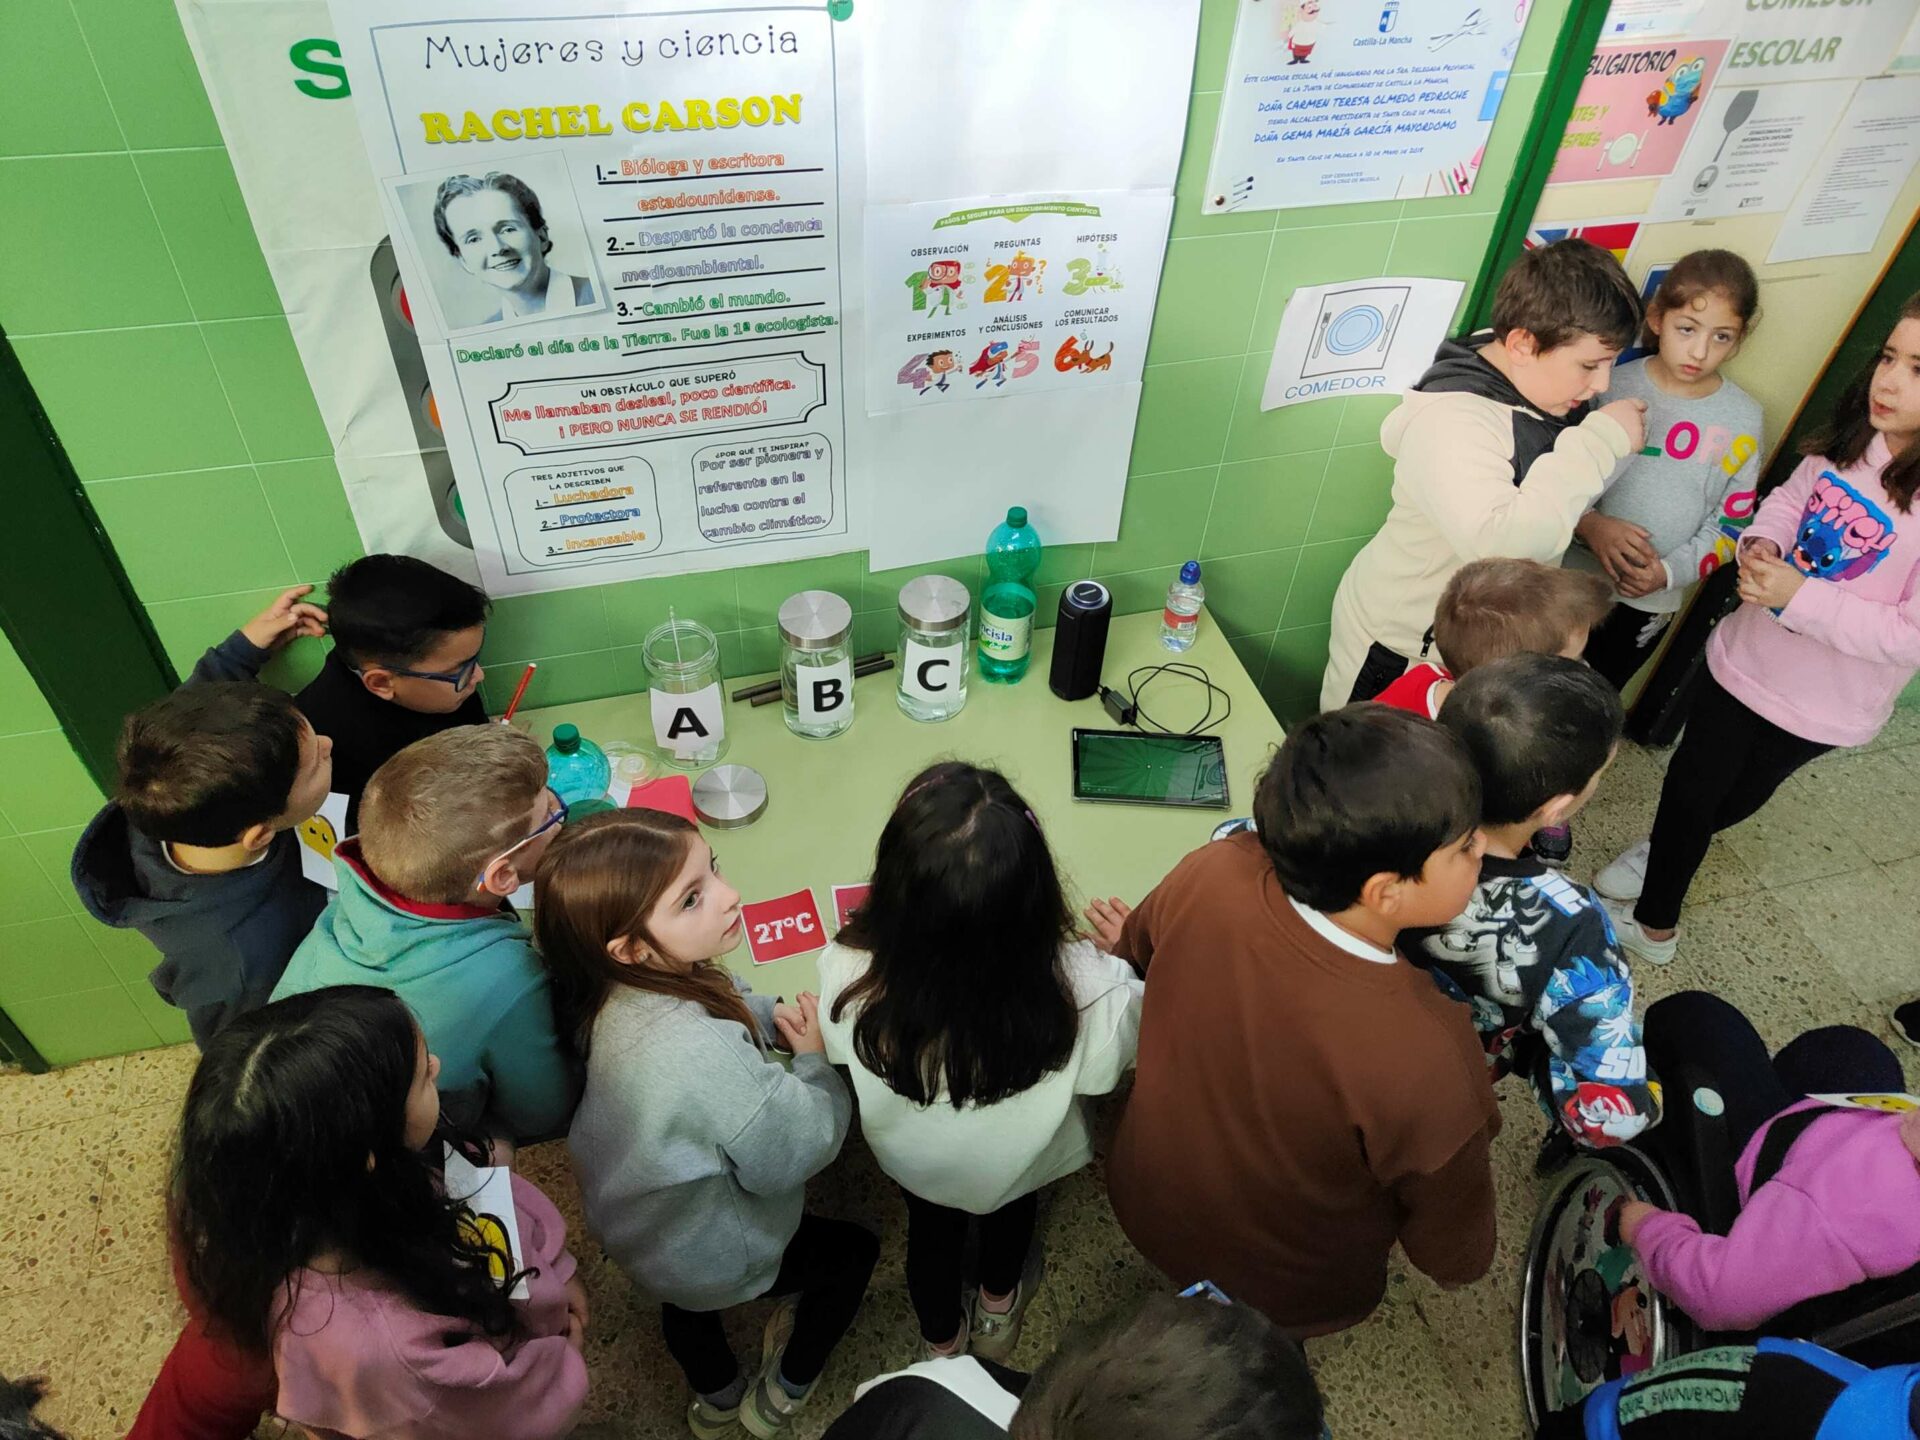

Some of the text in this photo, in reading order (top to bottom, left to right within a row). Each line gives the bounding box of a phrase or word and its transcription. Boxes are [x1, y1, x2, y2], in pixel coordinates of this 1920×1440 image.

[425, 24, 799, 72] Mujeres y ciencia
[1727, 37, 1842, 69] ESCOLAR
[1585, 49, 1677, 76] BLIGATORIO
[420, 93, 803, 144] RACHEL CARSON
[620, 158, 689, 177] Bióloga
[692, 158, 704, 174] y
[708, 153, 785, 170] escritora
[637, 188, 781, 212] estadounidense.
[638, 224, 717, 247] Despertó
[721, 223, 736, 238] la
[994, 238, 1041, 250] PREGUNTAS
[1076, 232, 1118, 244] HIPÓTESIS
[911, 243, 969, 257] OBSERVACIÓN
[622, 255, 765, 283] medioambiental.
[709, 293, 724, 308] el
[728, 289, 791, 308] mundo.
[993, 313, 1028, 324] ANÁLISIS
[1054, 315, 1118, 327] LOS RESULTADOS
[1064, 307, 1109, 318] COMUNICAR
[456, 343, 524, 363] Declaró
[527, 342, 544, 357] el
[547, 340, 574, 355] día
[578, 338, 600, 351] de
[603, 336, 620, 350] la
[623, 332, 677, 348] Tierra.
[681, 327, 711, 342] Fue
[714, 324, 729, 338] la
[754, 314, 839, 333] ecologista.
[907, 328, 966, 342] EXPERIMENTOS
[978, 322, 1043, 334] Y CONCLUSIONES
[580, 370, 736, 398] UN OBSTÁCULO QUE SUPERÓ
[1284, 375, 1386, 400] COMEDOR
[503, 378, 796, 422] Me llamaban desleal, poco científica.
[569, 422, 614, 437] PERO
[617, 413, 676, 432] NUNCA
[680, 408, 698, 423] SE
[702, 396, 768, 420] RENDIÓ!
[700, 448, 824, 472] Por ser pionera y
[739, 447, 755, 456] QUÉ
[758, 446, 768, 454] TE
[770, 441, 810, 452] INSPIRA?
[531, 465, 625, 482] TRES ADJETIVOS QUE
[564, 478, 612, 489] DESCRIBEN
[698, 470, 806, 495] referente en la
[554, 485, 634, 505] Luchadora
[700, 492, 806, 517] lucha contra el
[560, 508, 640, 526] Protectora
[703, 514, 826, 538] cambio climático.
[566, 530, 646, 550] Incansable
[916, 659, 951, 692] C
[812, 678, 845, 713] B
[667, 707, 710, 740] A
